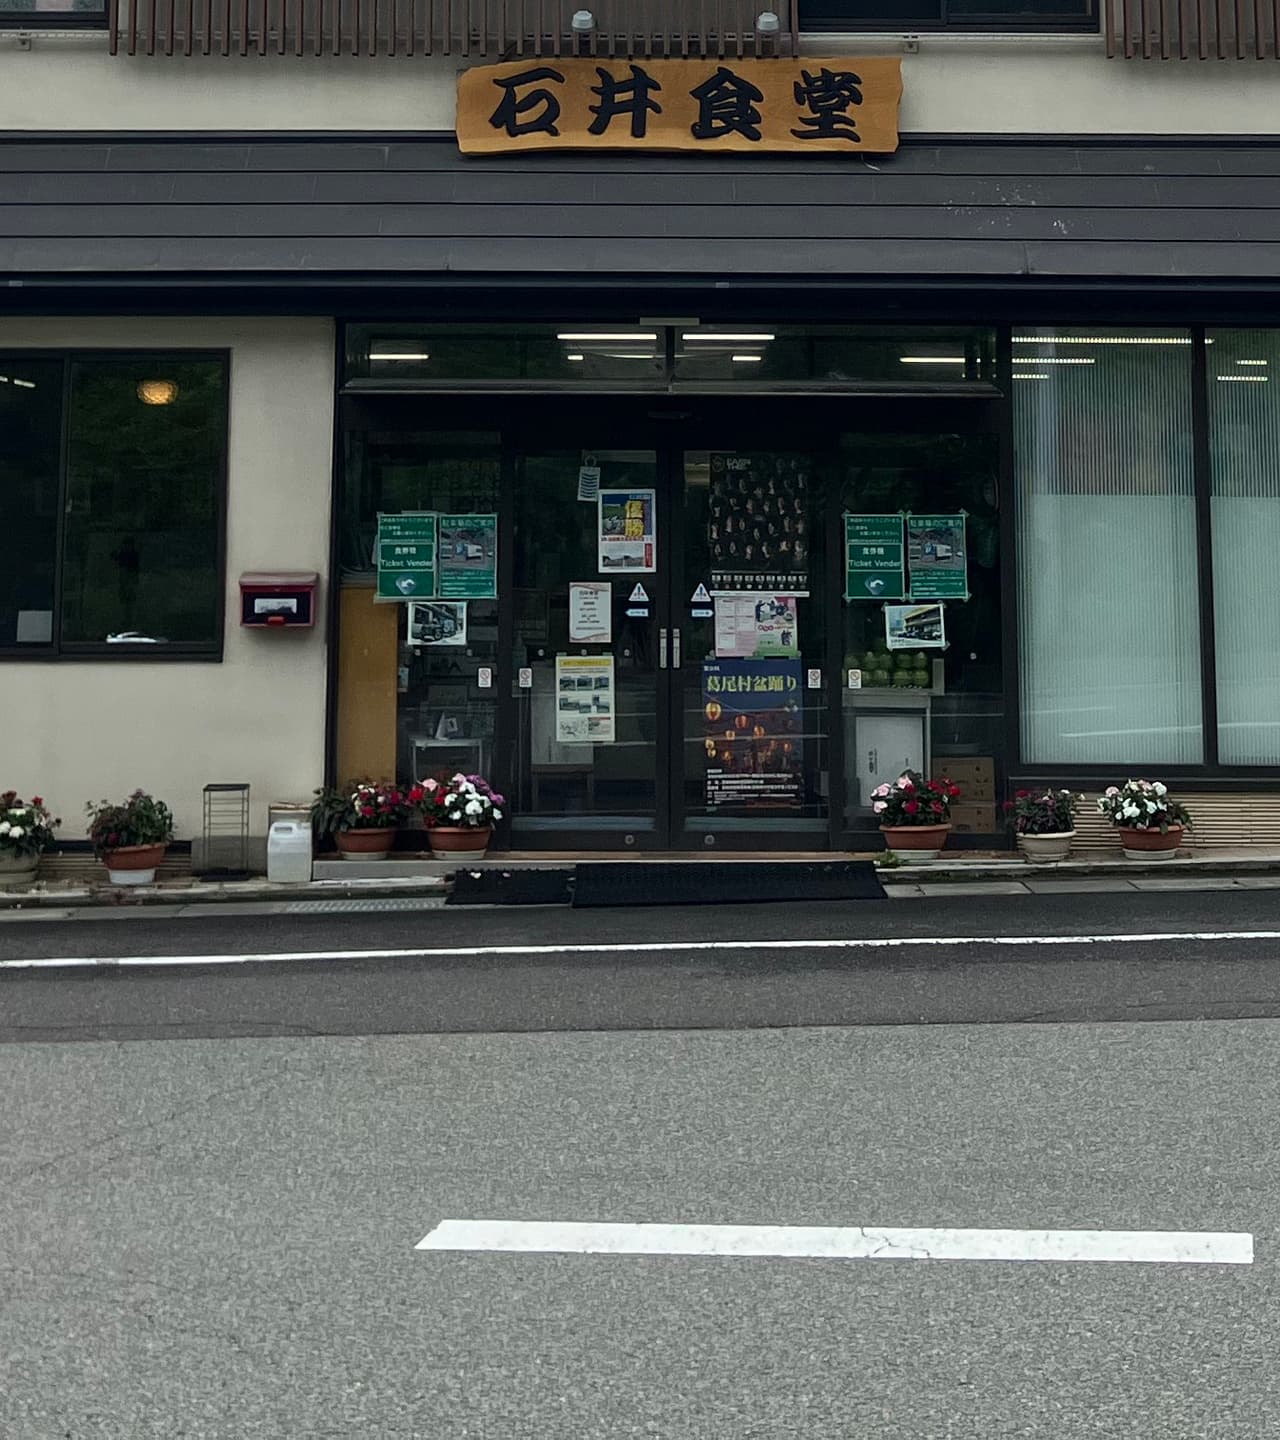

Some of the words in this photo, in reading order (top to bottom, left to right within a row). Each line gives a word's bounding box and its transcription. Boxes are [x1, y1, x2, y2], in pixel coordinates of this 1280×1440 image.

[488, 64, 863, 143] 石井食堂
[910, 518, 962, 528] 駐車場のご案内
[381, 559, 404, 568] Ticket
[849, 559, 873, 568] Ticket
[707, 675, 797, 692] 葛尾村盆踊り
